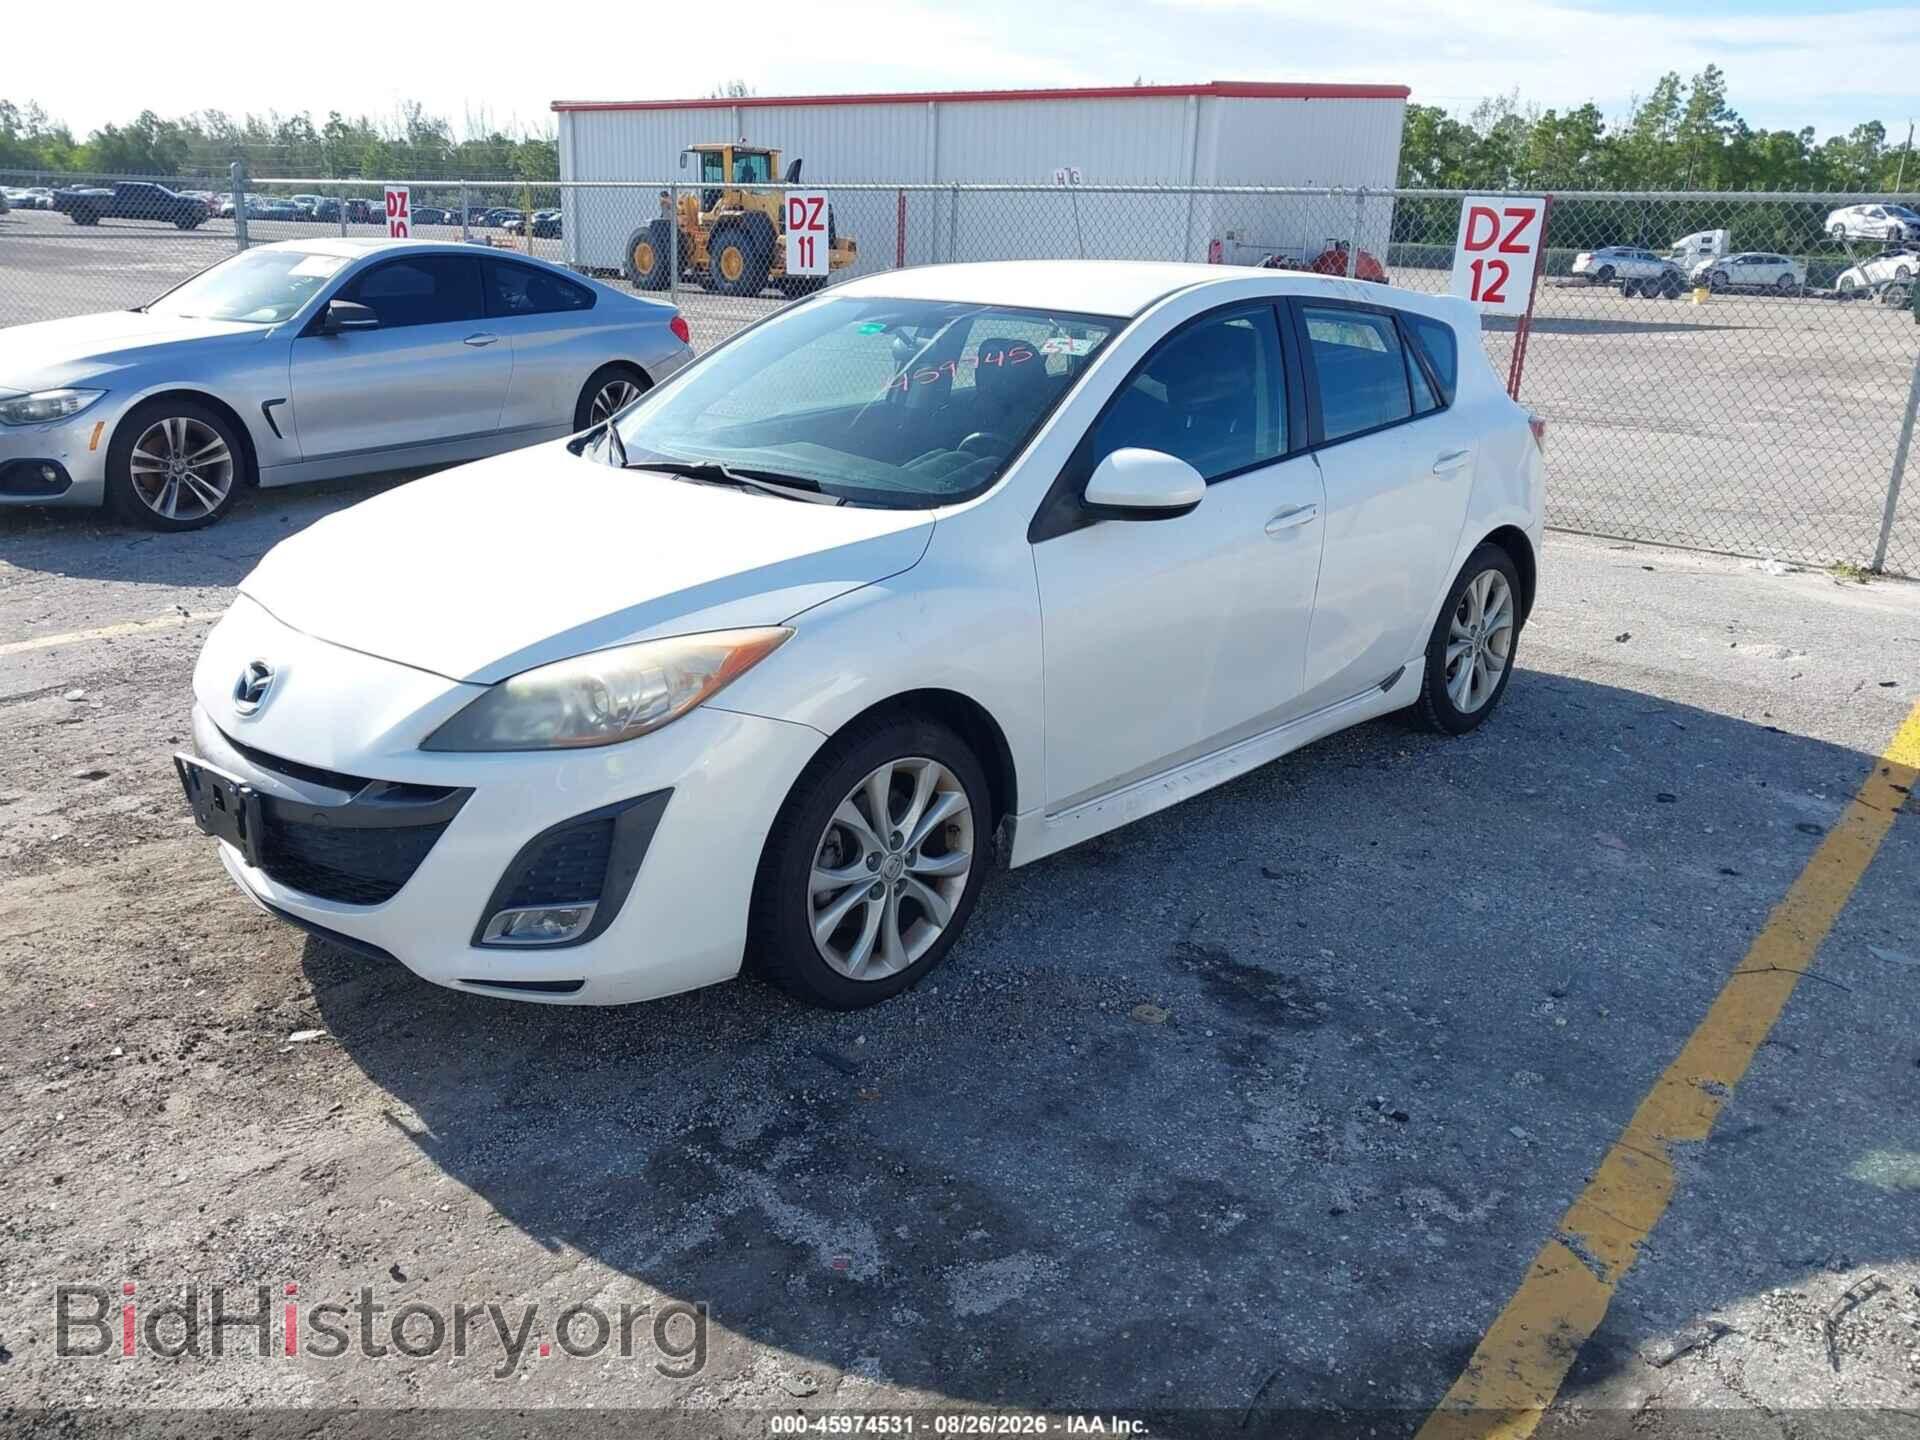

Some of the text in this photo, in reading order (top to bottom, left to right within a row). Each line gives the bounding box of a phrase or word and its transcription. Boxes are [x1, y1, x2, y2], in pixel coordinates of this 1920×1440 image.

[386, 191, 408, 217] DZ
[789, 197, 825, 230] DZ
[1464, 206, 1536, 253] DZ
[798, 236, 814, 268] 11
[1470, 259, 1509, 303] 12
